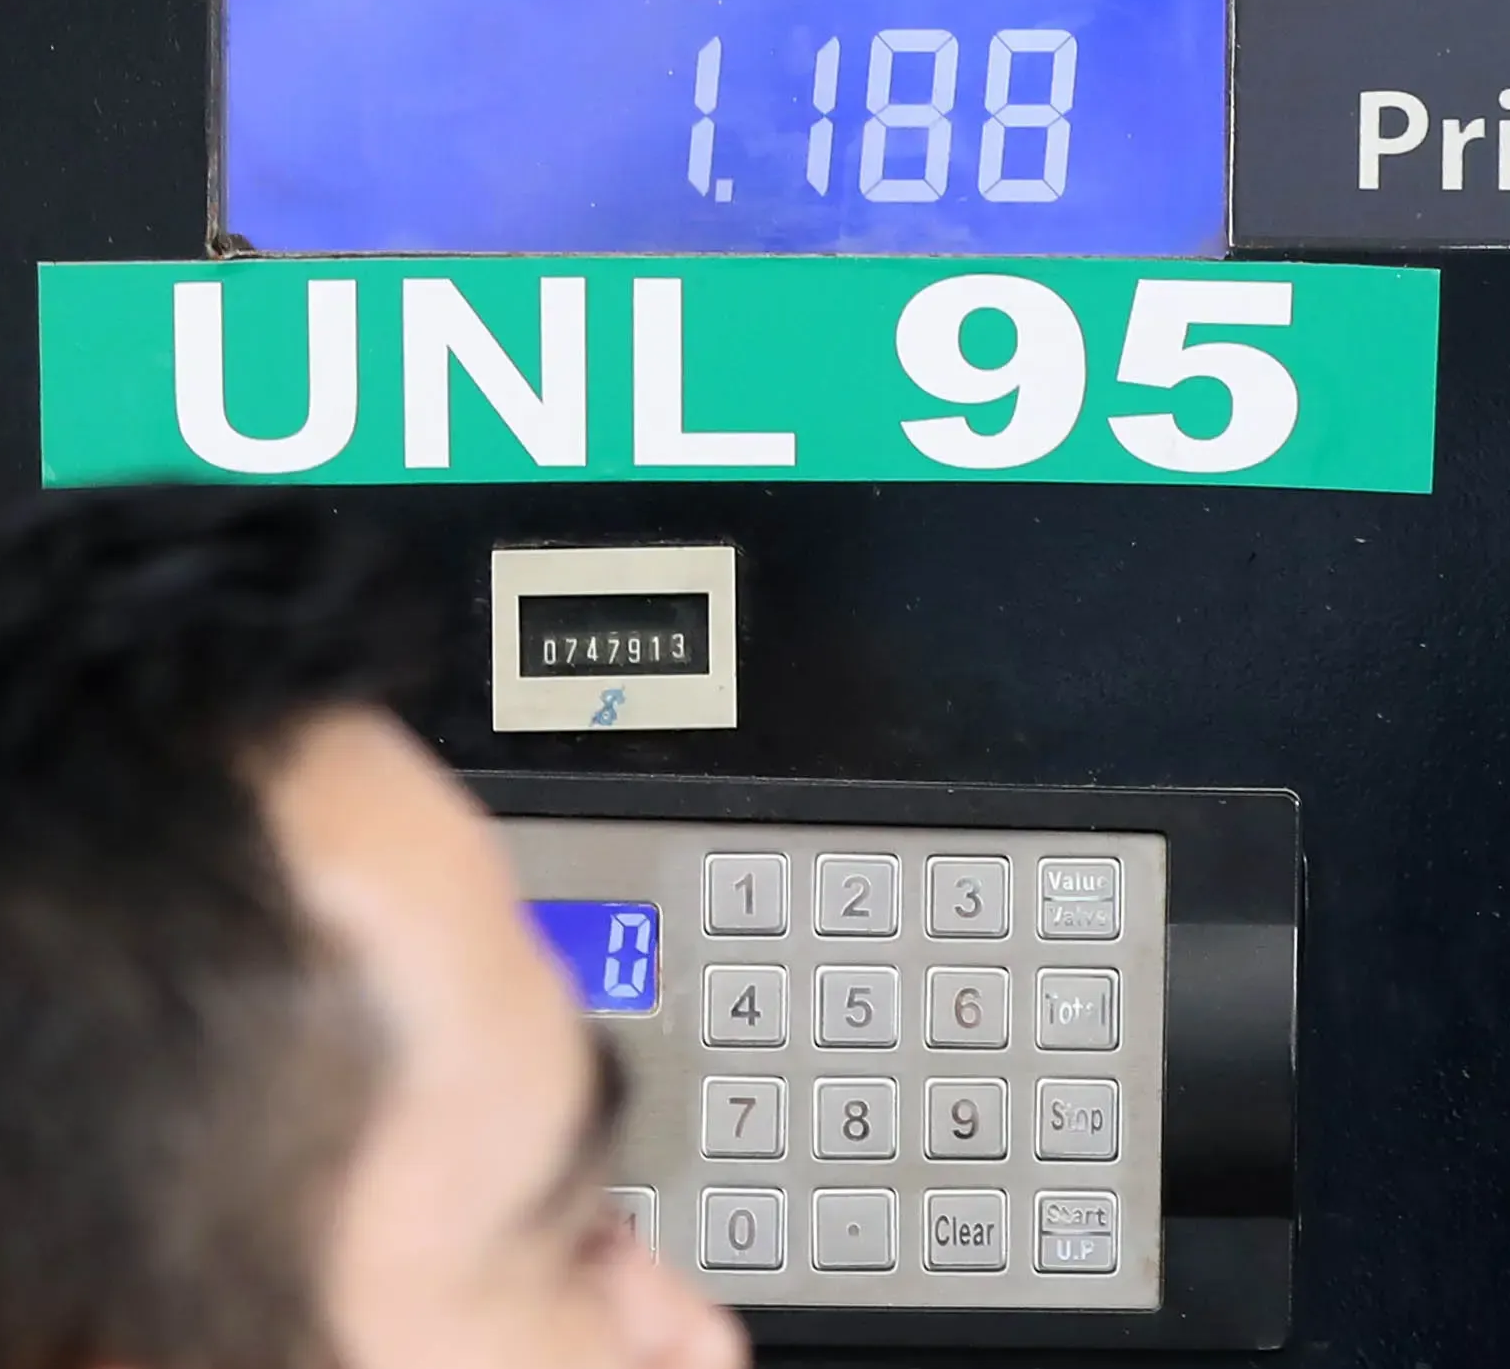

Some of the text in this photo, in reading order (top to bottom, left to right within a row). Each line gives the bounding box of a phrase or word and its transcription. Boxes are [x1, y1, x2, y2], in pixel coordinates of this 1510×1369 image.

[687, 28, 1078, 202] 1.188
[173, 273, 1299, 475] UNL 95
[543, 633, 686, 665] 0747913
[732, 872, 754, 915] 1
[841, 876, 872, 918] 2
[954, 877, 984, 919] 3
[603, 912, 651, 999] 0
[731, 985, 761, 1027] 4
[845, 987, 875, 1029] 5
[954, 988, 983, 1030] 6
[728, 1097, 757, 1139] 7
[843, 1100, 871, 1142] 8
[951, 1099, 980, 1140] 9
[728, 1208, 757, 1251] 0
[934, 1215, 995, 1247] Clear
